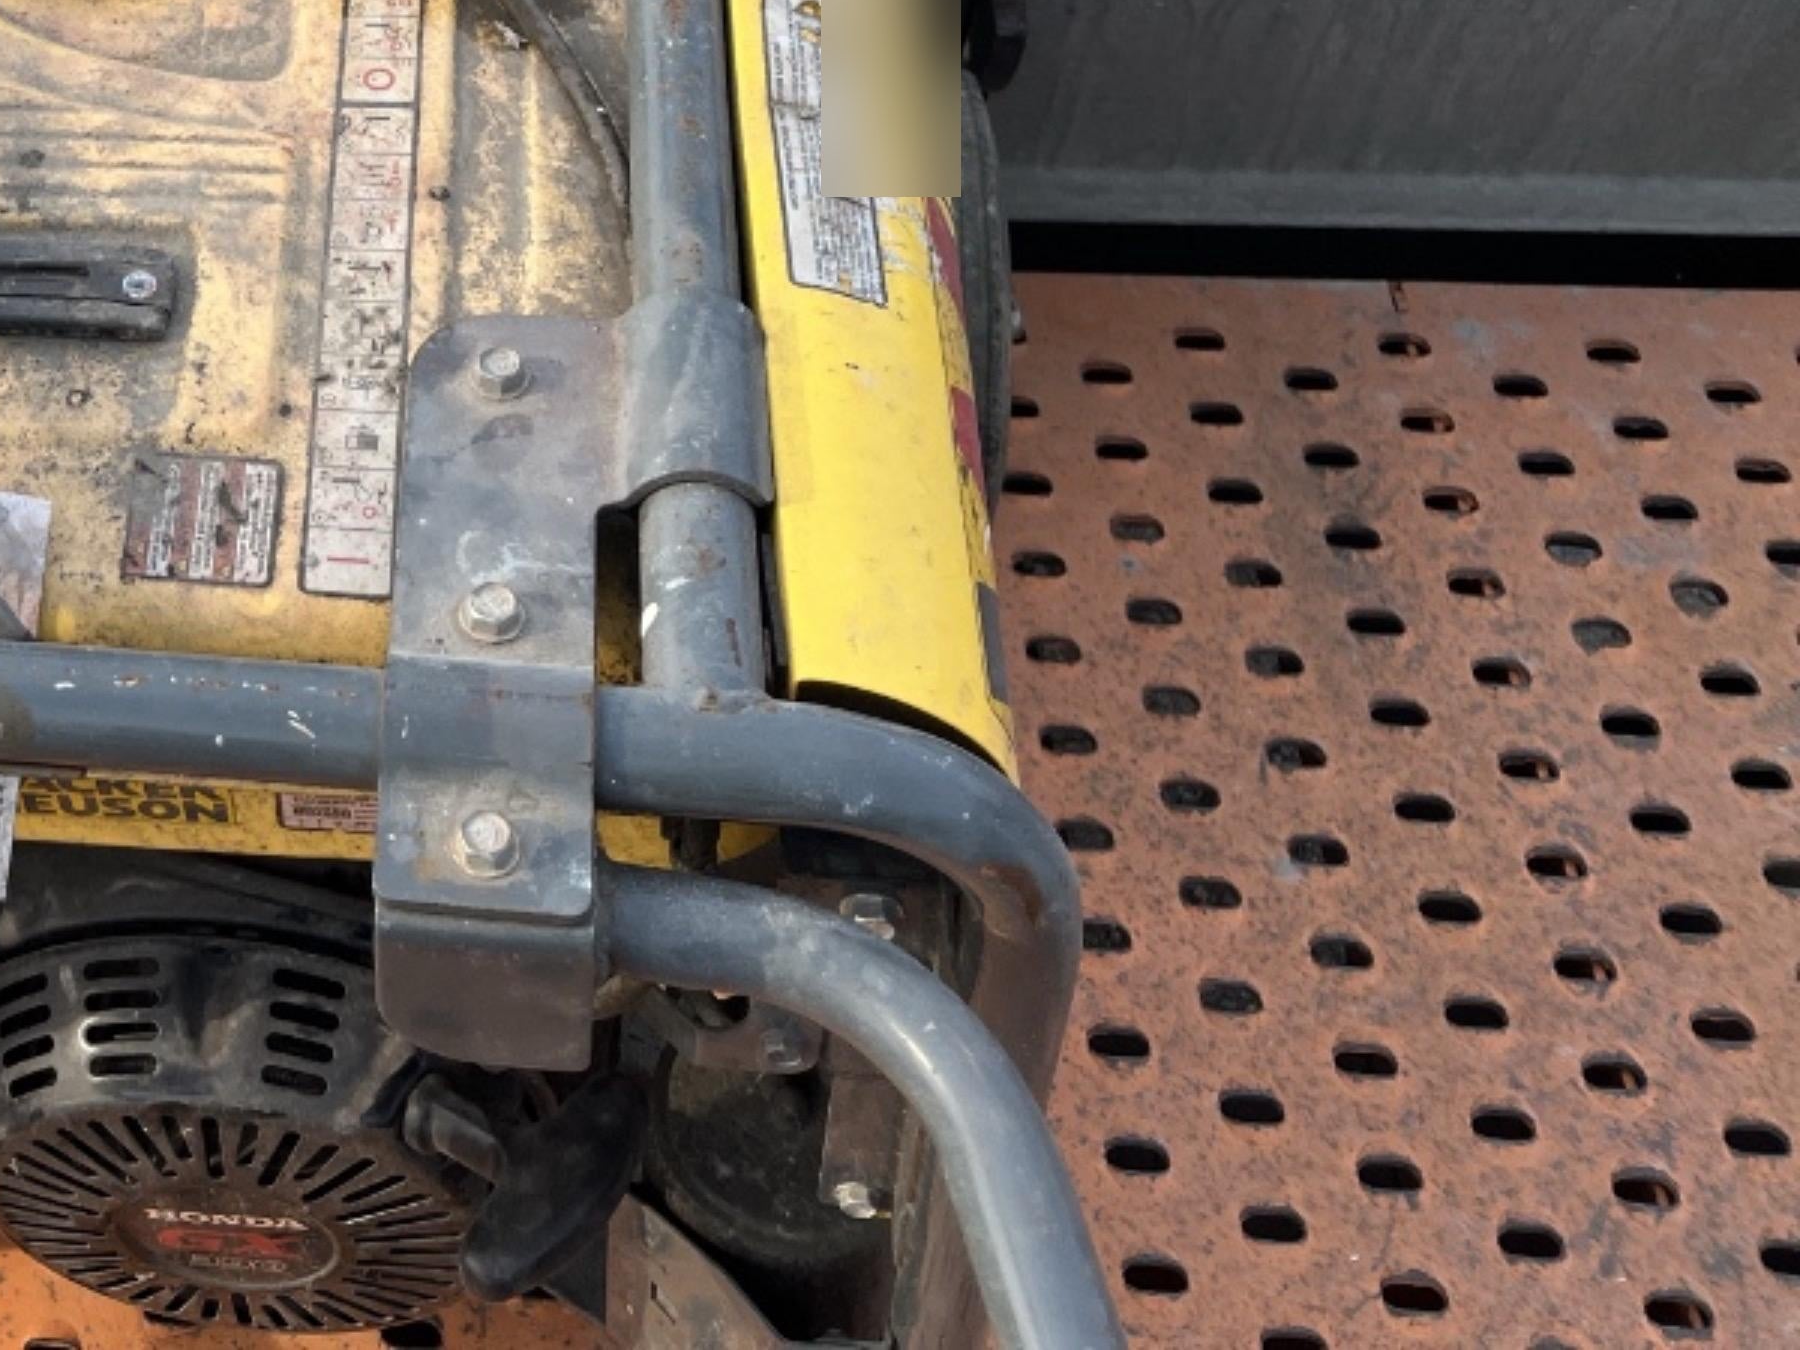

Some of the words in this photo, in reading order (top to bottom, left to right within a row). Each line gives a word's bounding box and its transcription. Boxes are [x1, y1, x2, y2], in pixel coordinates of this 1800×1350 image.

[21, 776, 226, 801] ACKER
[16, 792, 229, 823] EUSON
[144, 1207, 309, 1231] HONDA
